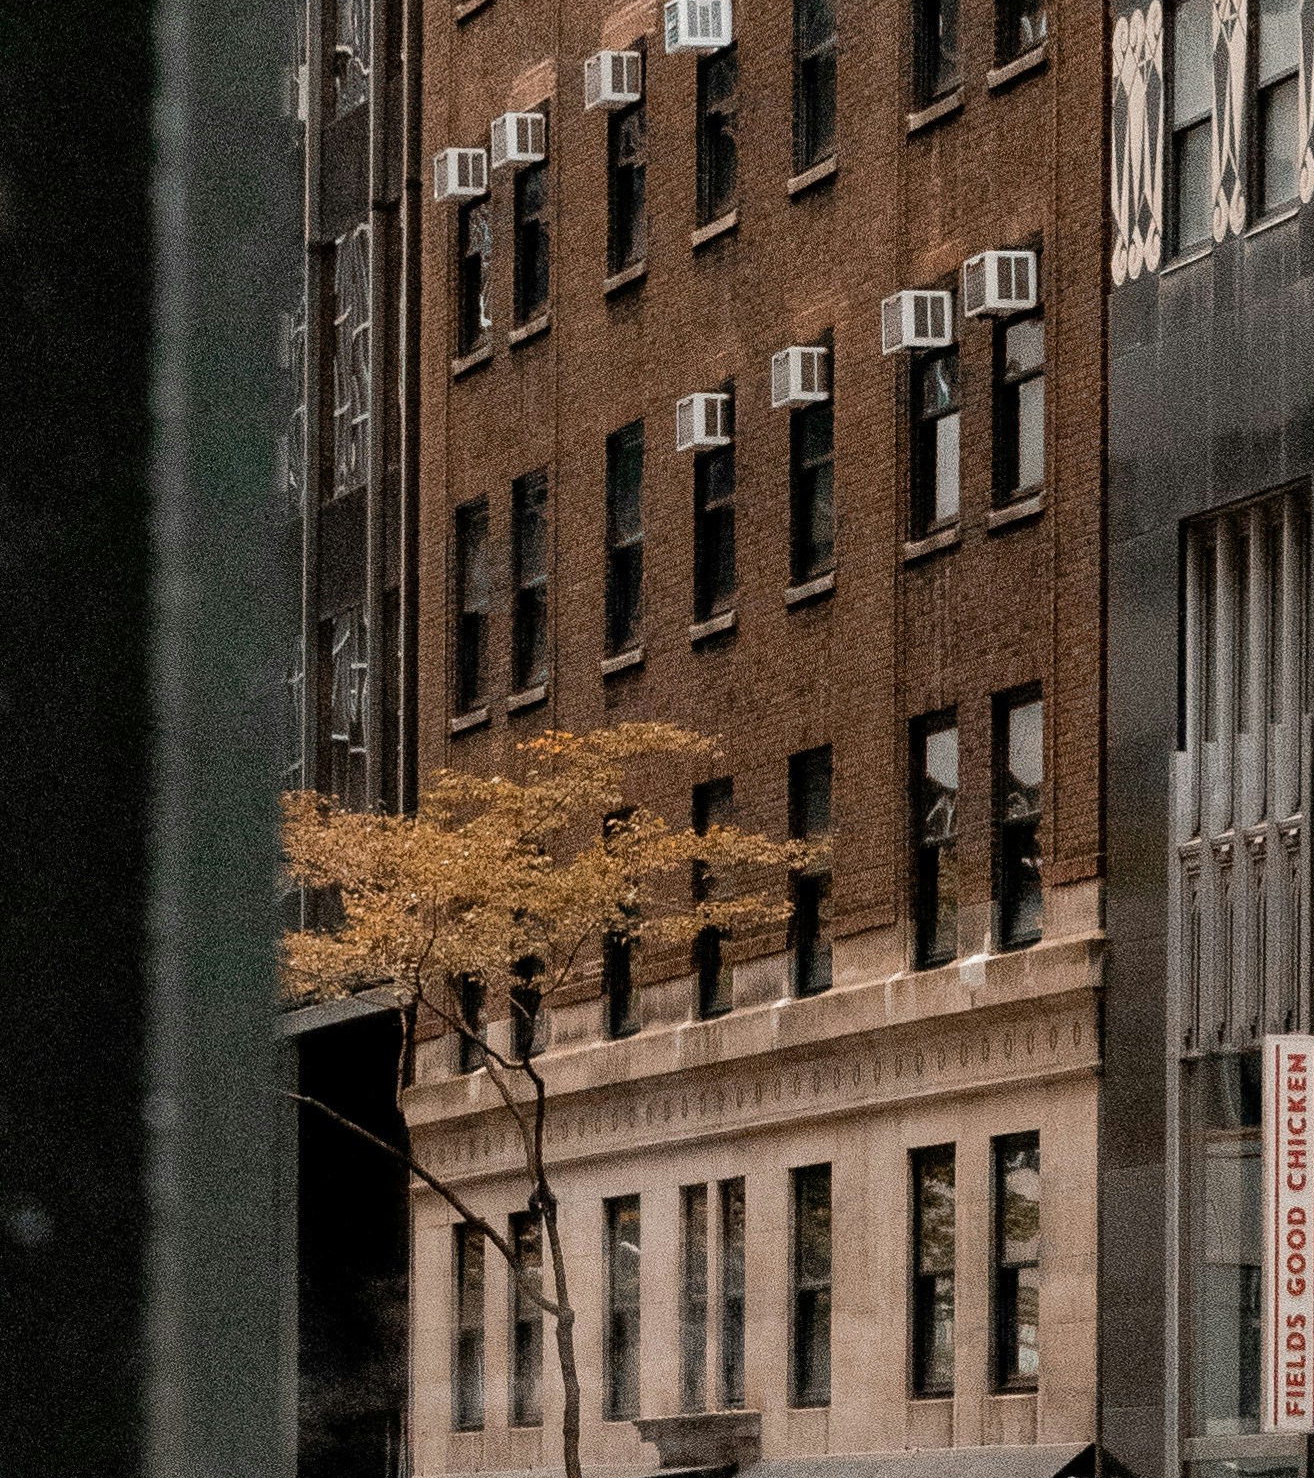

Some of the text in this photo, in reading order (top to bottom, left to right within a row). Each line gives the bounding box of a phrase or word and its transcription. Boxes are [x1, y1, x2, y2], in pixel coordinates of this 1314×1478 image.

[1285, 1053, 1307, 1417] FIELDS GOOD CHICKEN
